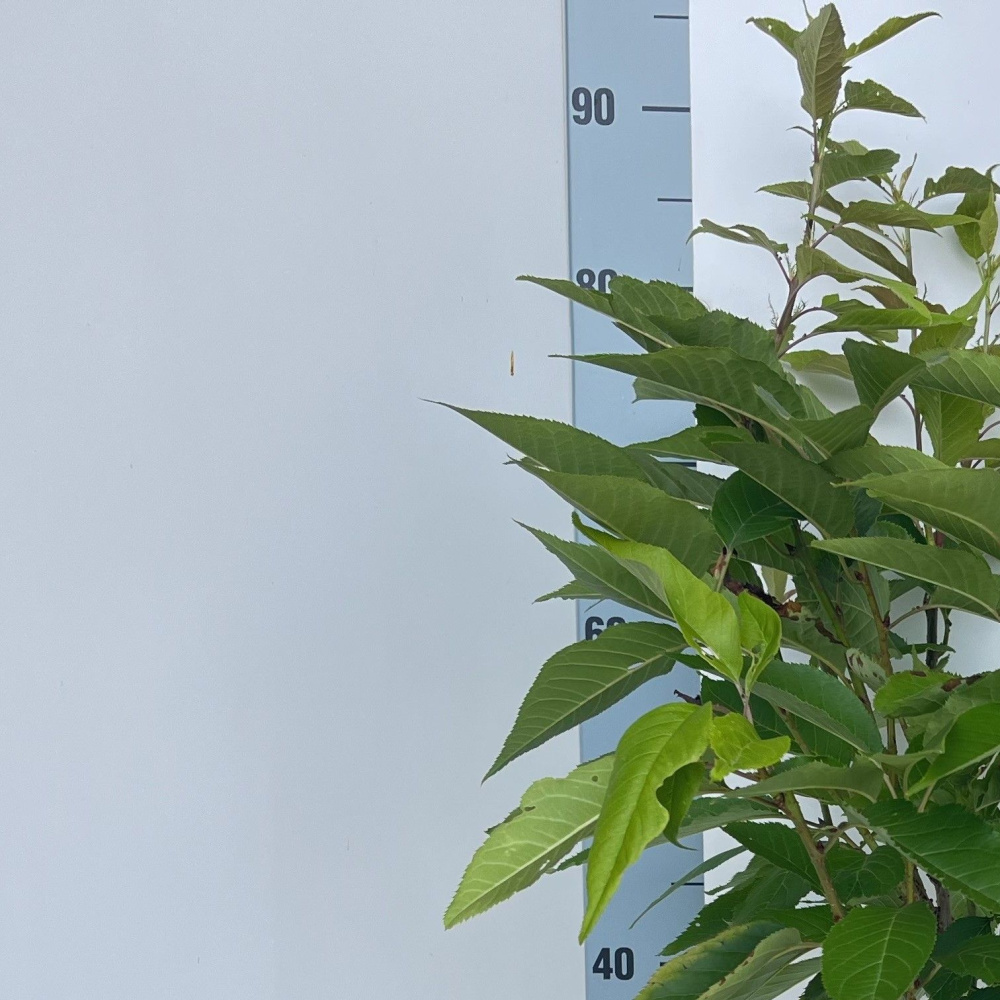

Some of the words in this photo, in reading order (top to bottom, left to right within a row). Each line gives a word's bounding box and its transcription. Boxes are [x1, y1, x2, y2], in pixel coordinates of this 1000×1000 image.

[571, 87, 615, 126] 90
[585, 616, 626, 641] 6
[592, 946, 635, 981] 40
